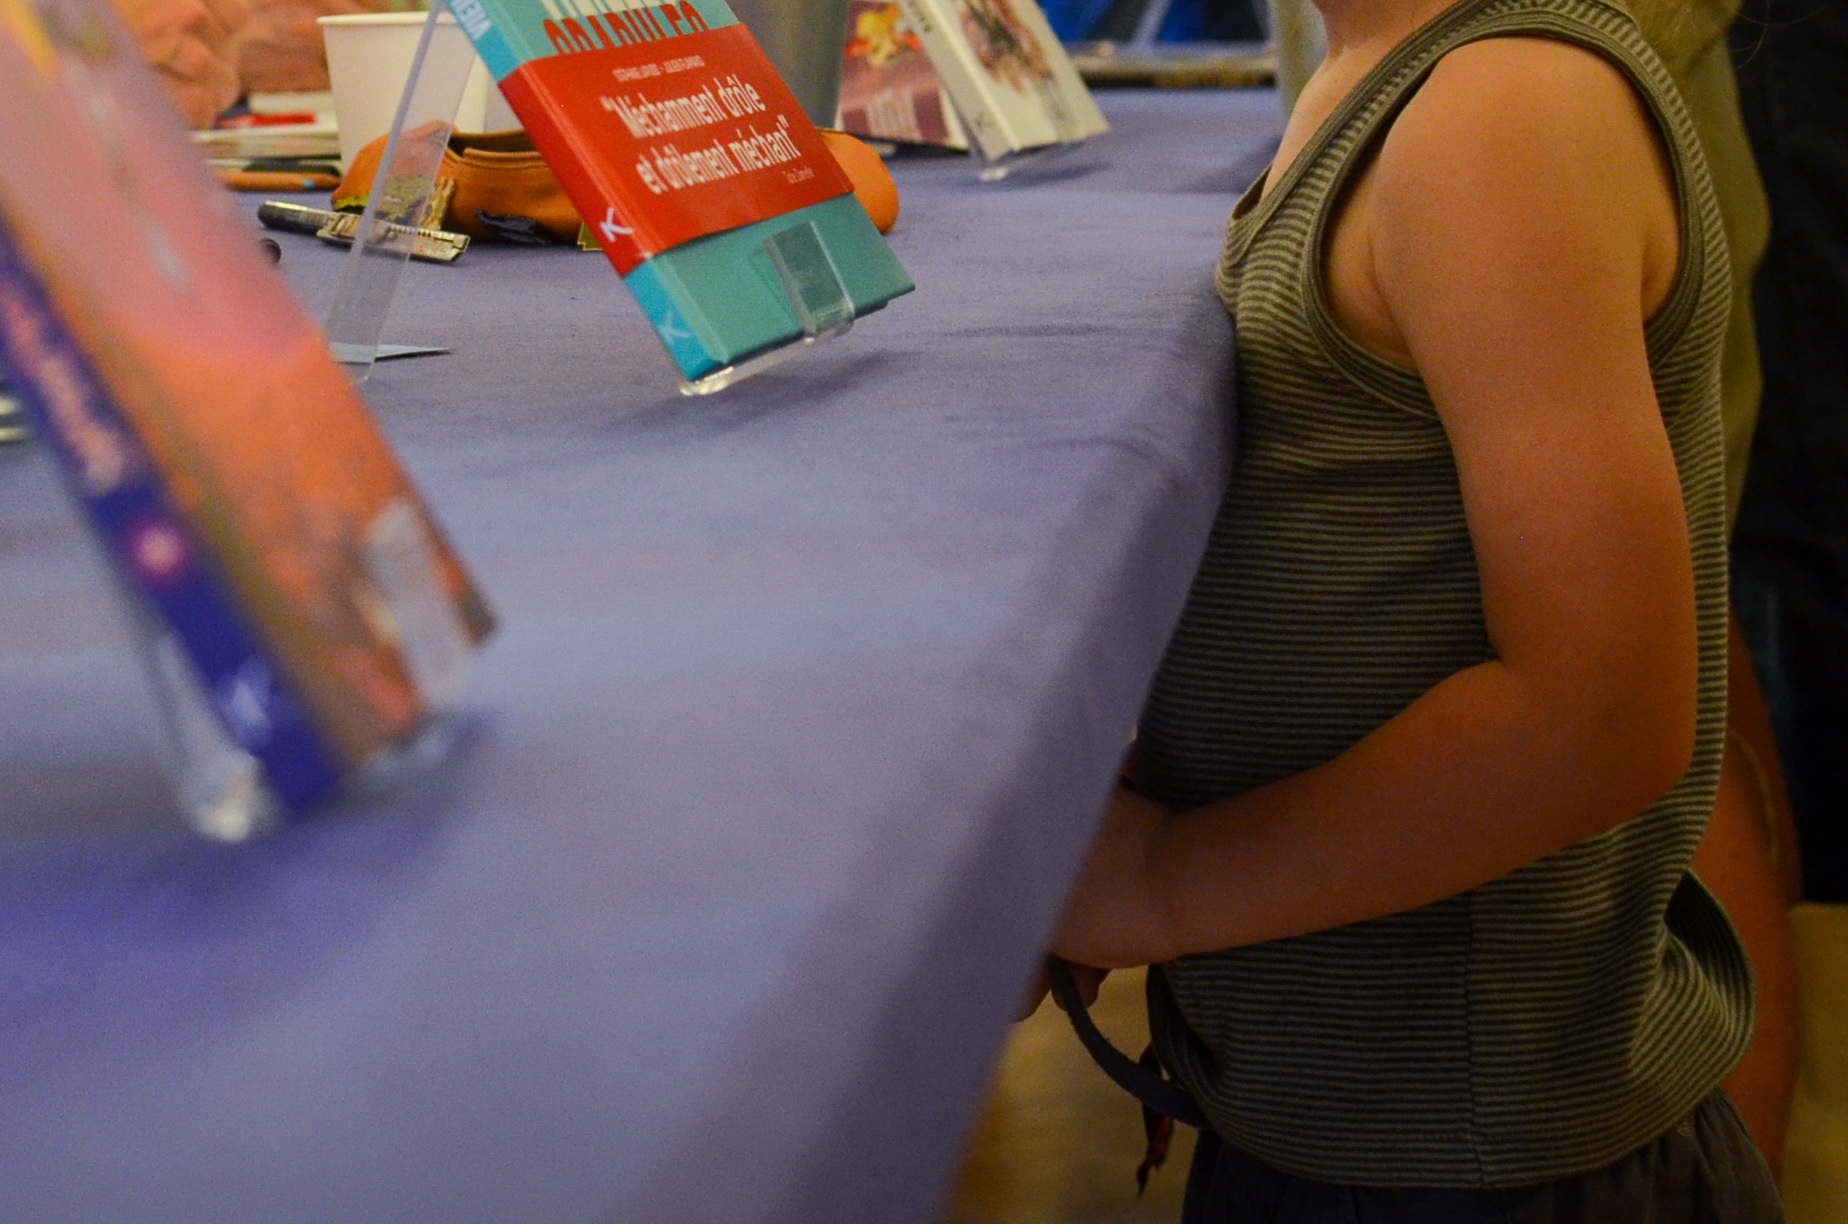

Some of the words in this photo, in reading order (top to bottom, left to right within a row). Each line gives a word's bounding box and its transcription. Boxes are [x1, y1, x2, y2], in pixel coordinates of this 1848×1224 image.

[713, 73, 766, 118] drôle
[635, 152, 669, 195] et
[649, 138, 740, 189] drôlement
